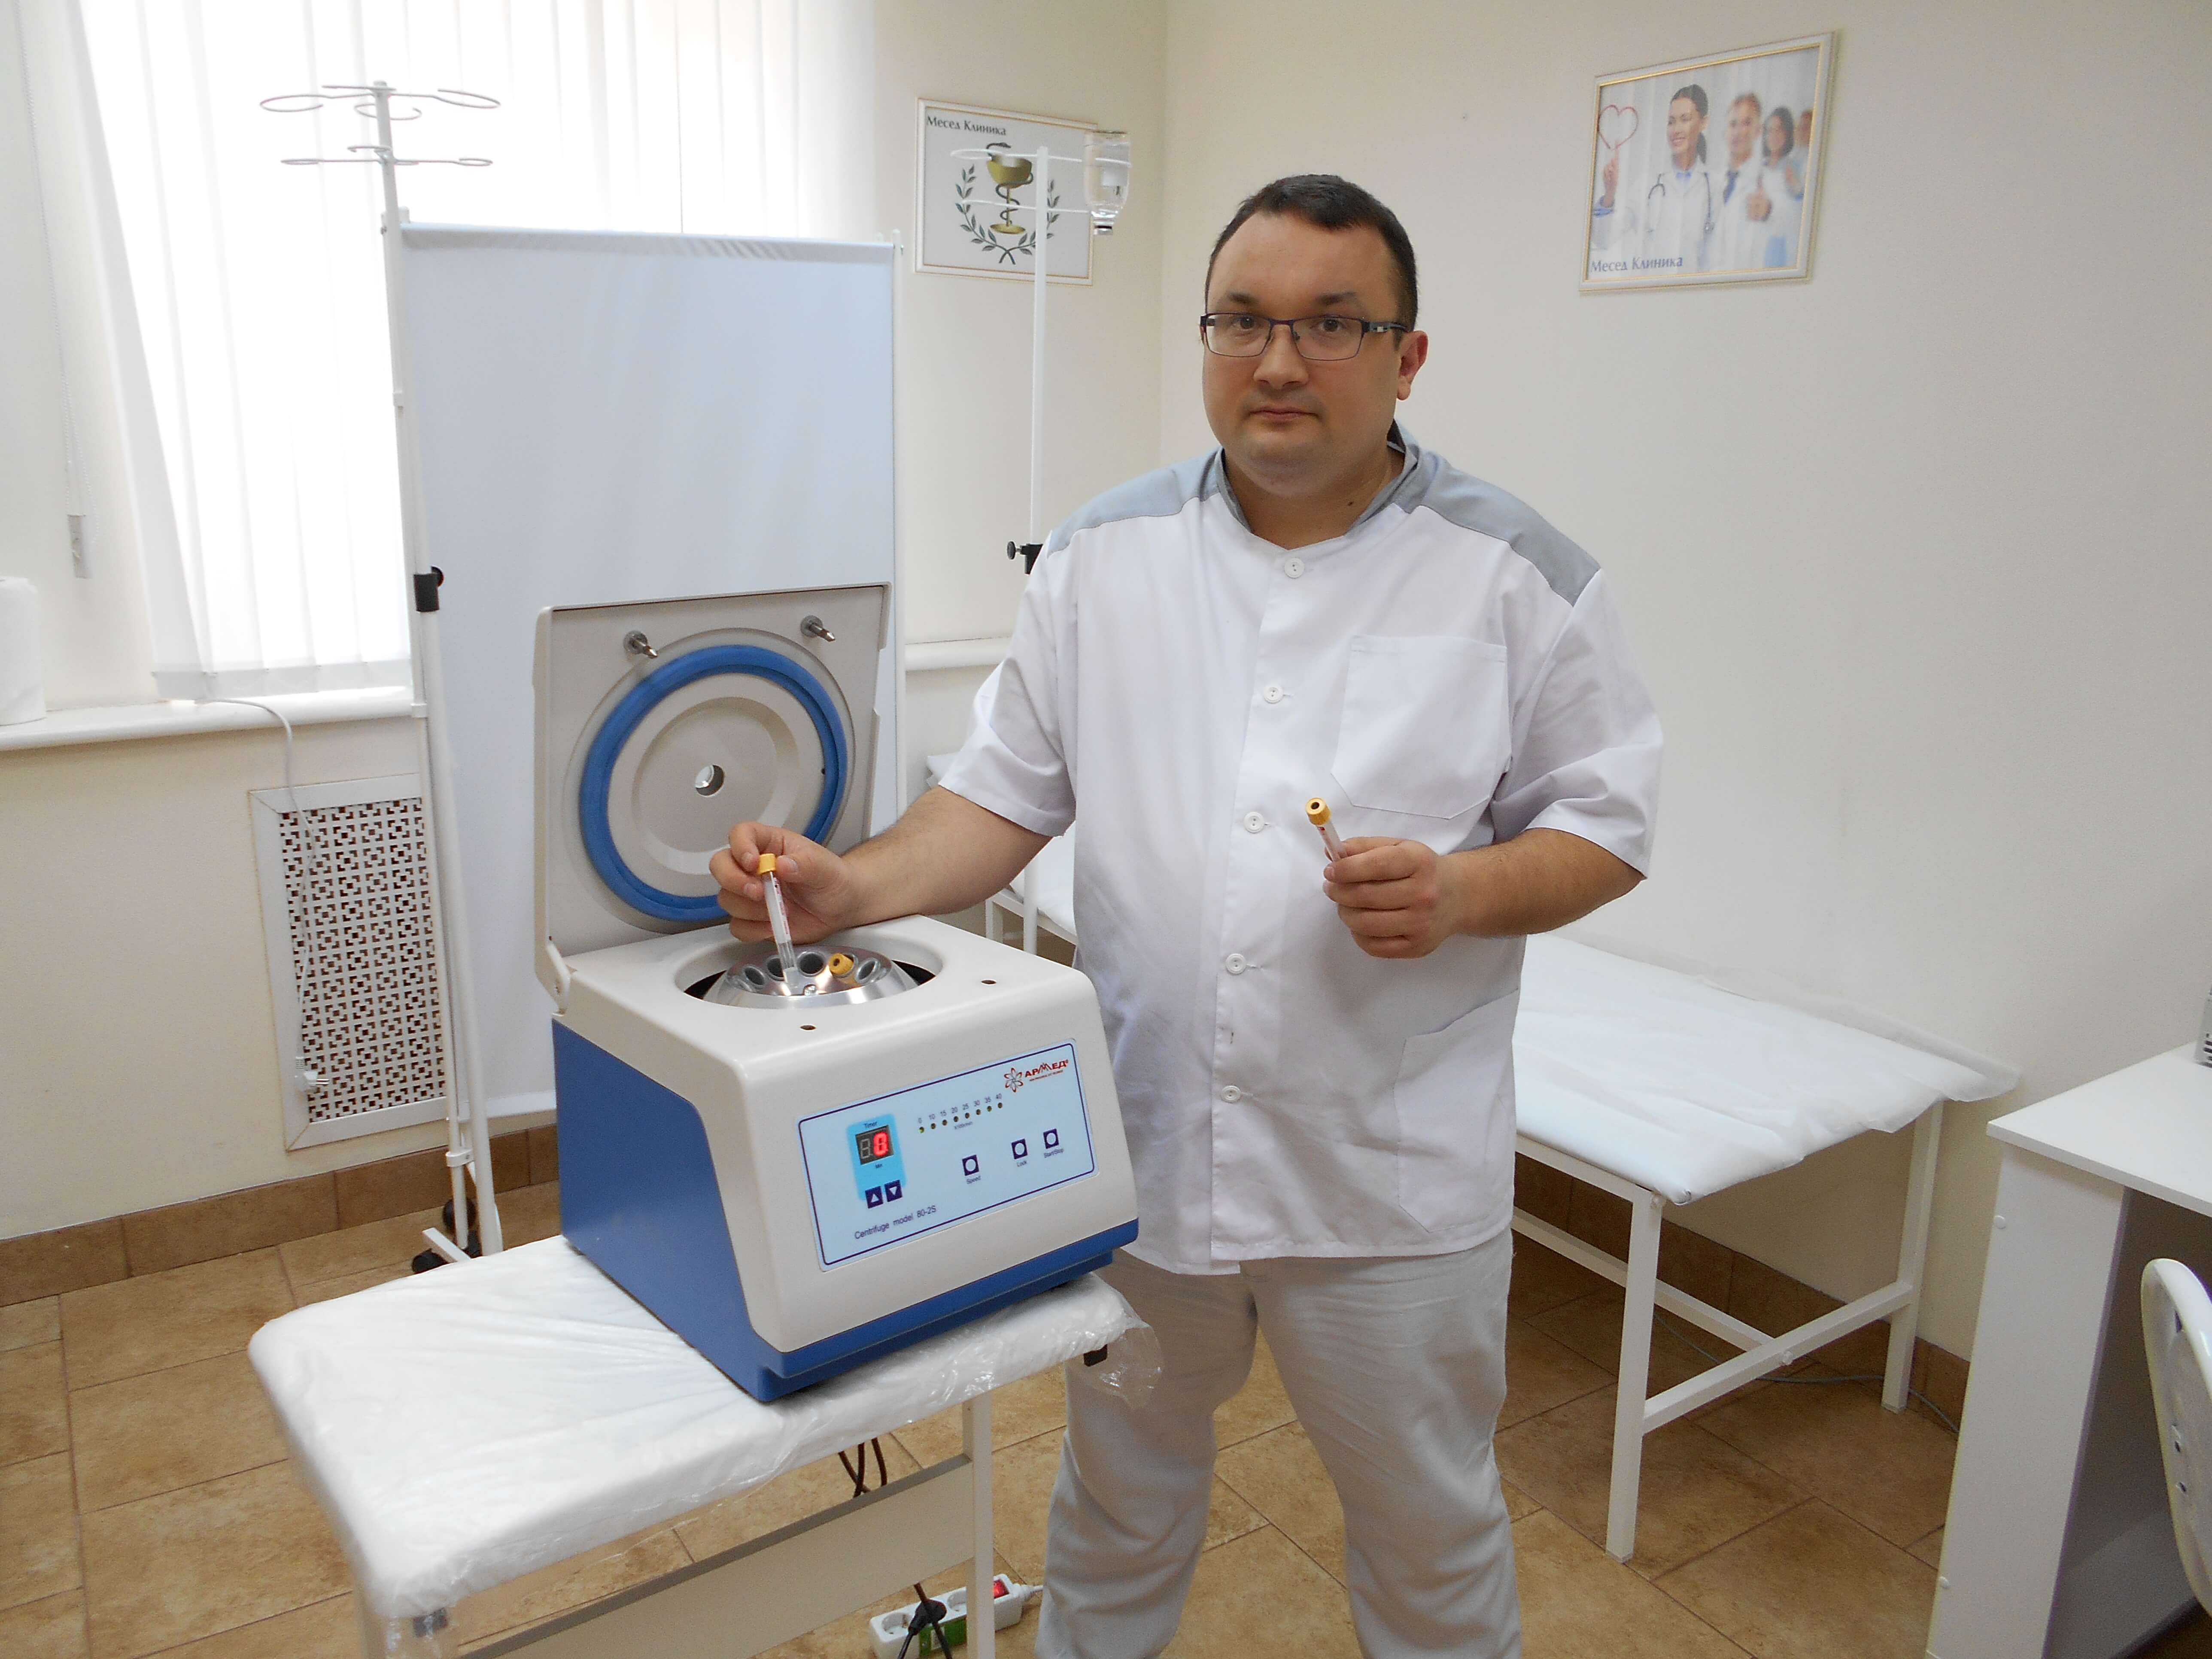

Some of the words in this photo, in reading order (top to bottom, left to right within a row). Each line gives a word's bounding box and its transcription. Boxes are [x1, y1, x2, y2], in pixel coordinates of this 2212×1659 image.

[927, 115, 960, 130] Месед
[964, 120, 1006, 136] Клиника
[1591, 260, 1628, 272] Месед
[1632, 257, 1683, 270] Клиника
[966, 1176, 981, 1184] Speed
[854, 1223, 890, 1239] Centrifuge
[893, 1213, 913, 1226] model
[917, 1205, 937, 1218] 80-2S
